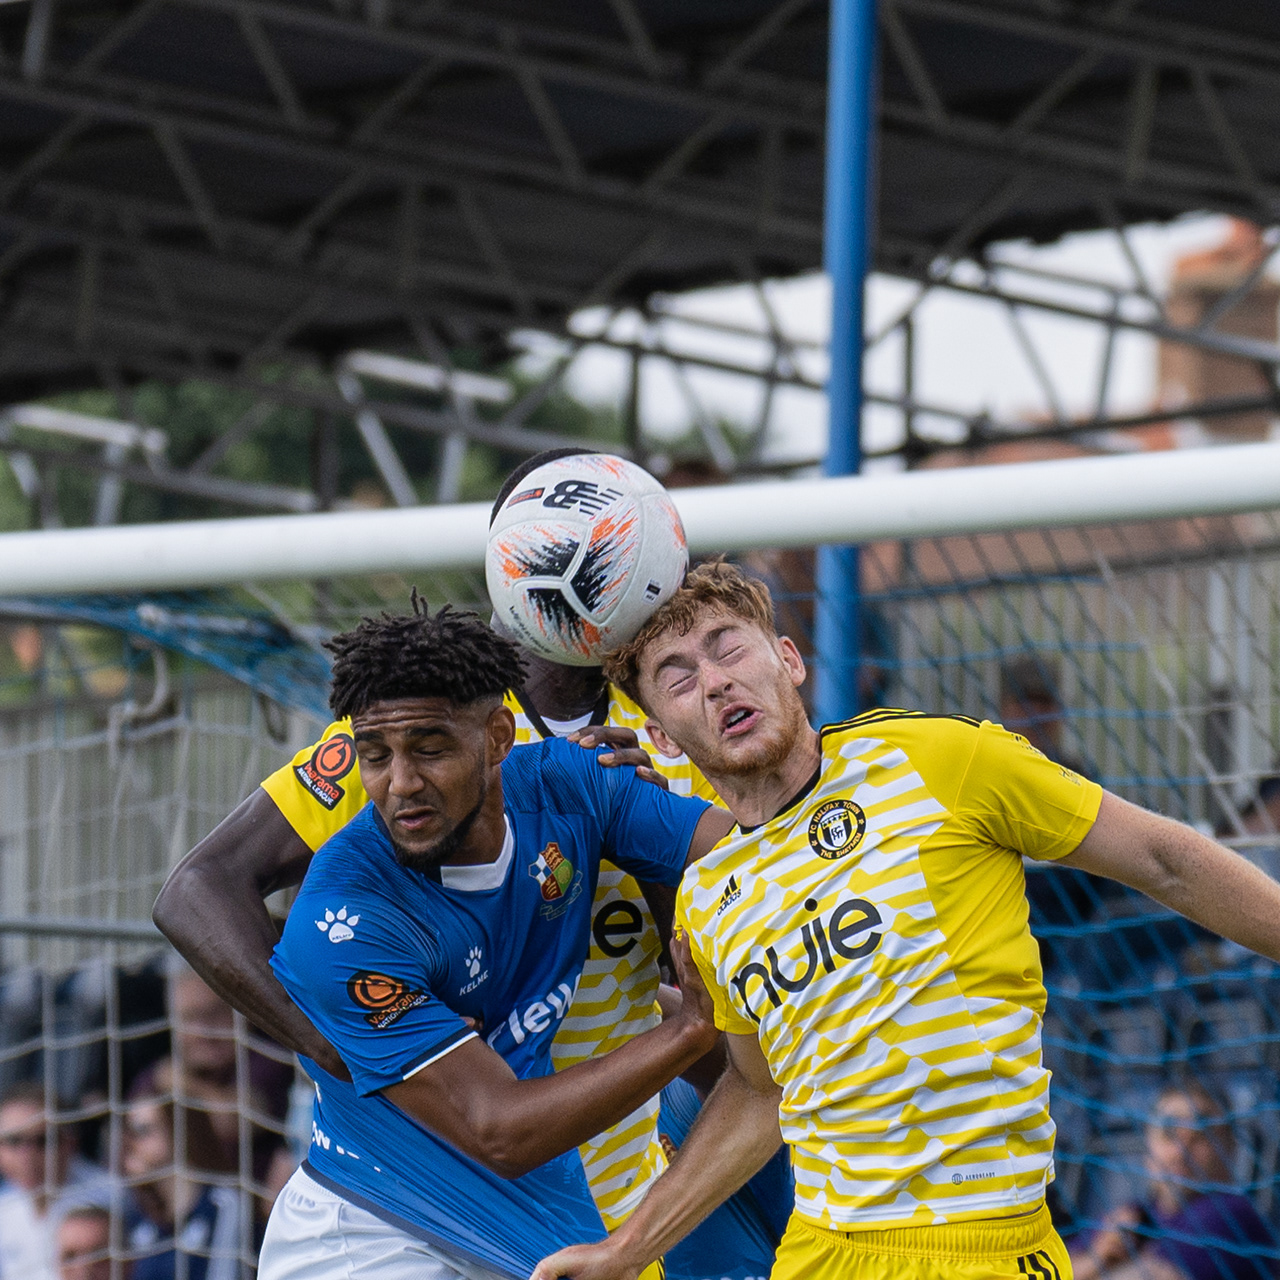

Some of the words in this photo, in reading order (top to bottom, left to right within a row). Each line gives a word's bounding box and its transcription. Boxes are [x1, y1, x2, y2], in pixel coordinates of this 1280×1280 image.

[813, 802, 840, 823] HALIFAX
[717, 888, 741, 916] adidas
[730, 898, 883, 1024] nuie
[458, 969, 490, 997] KELME
